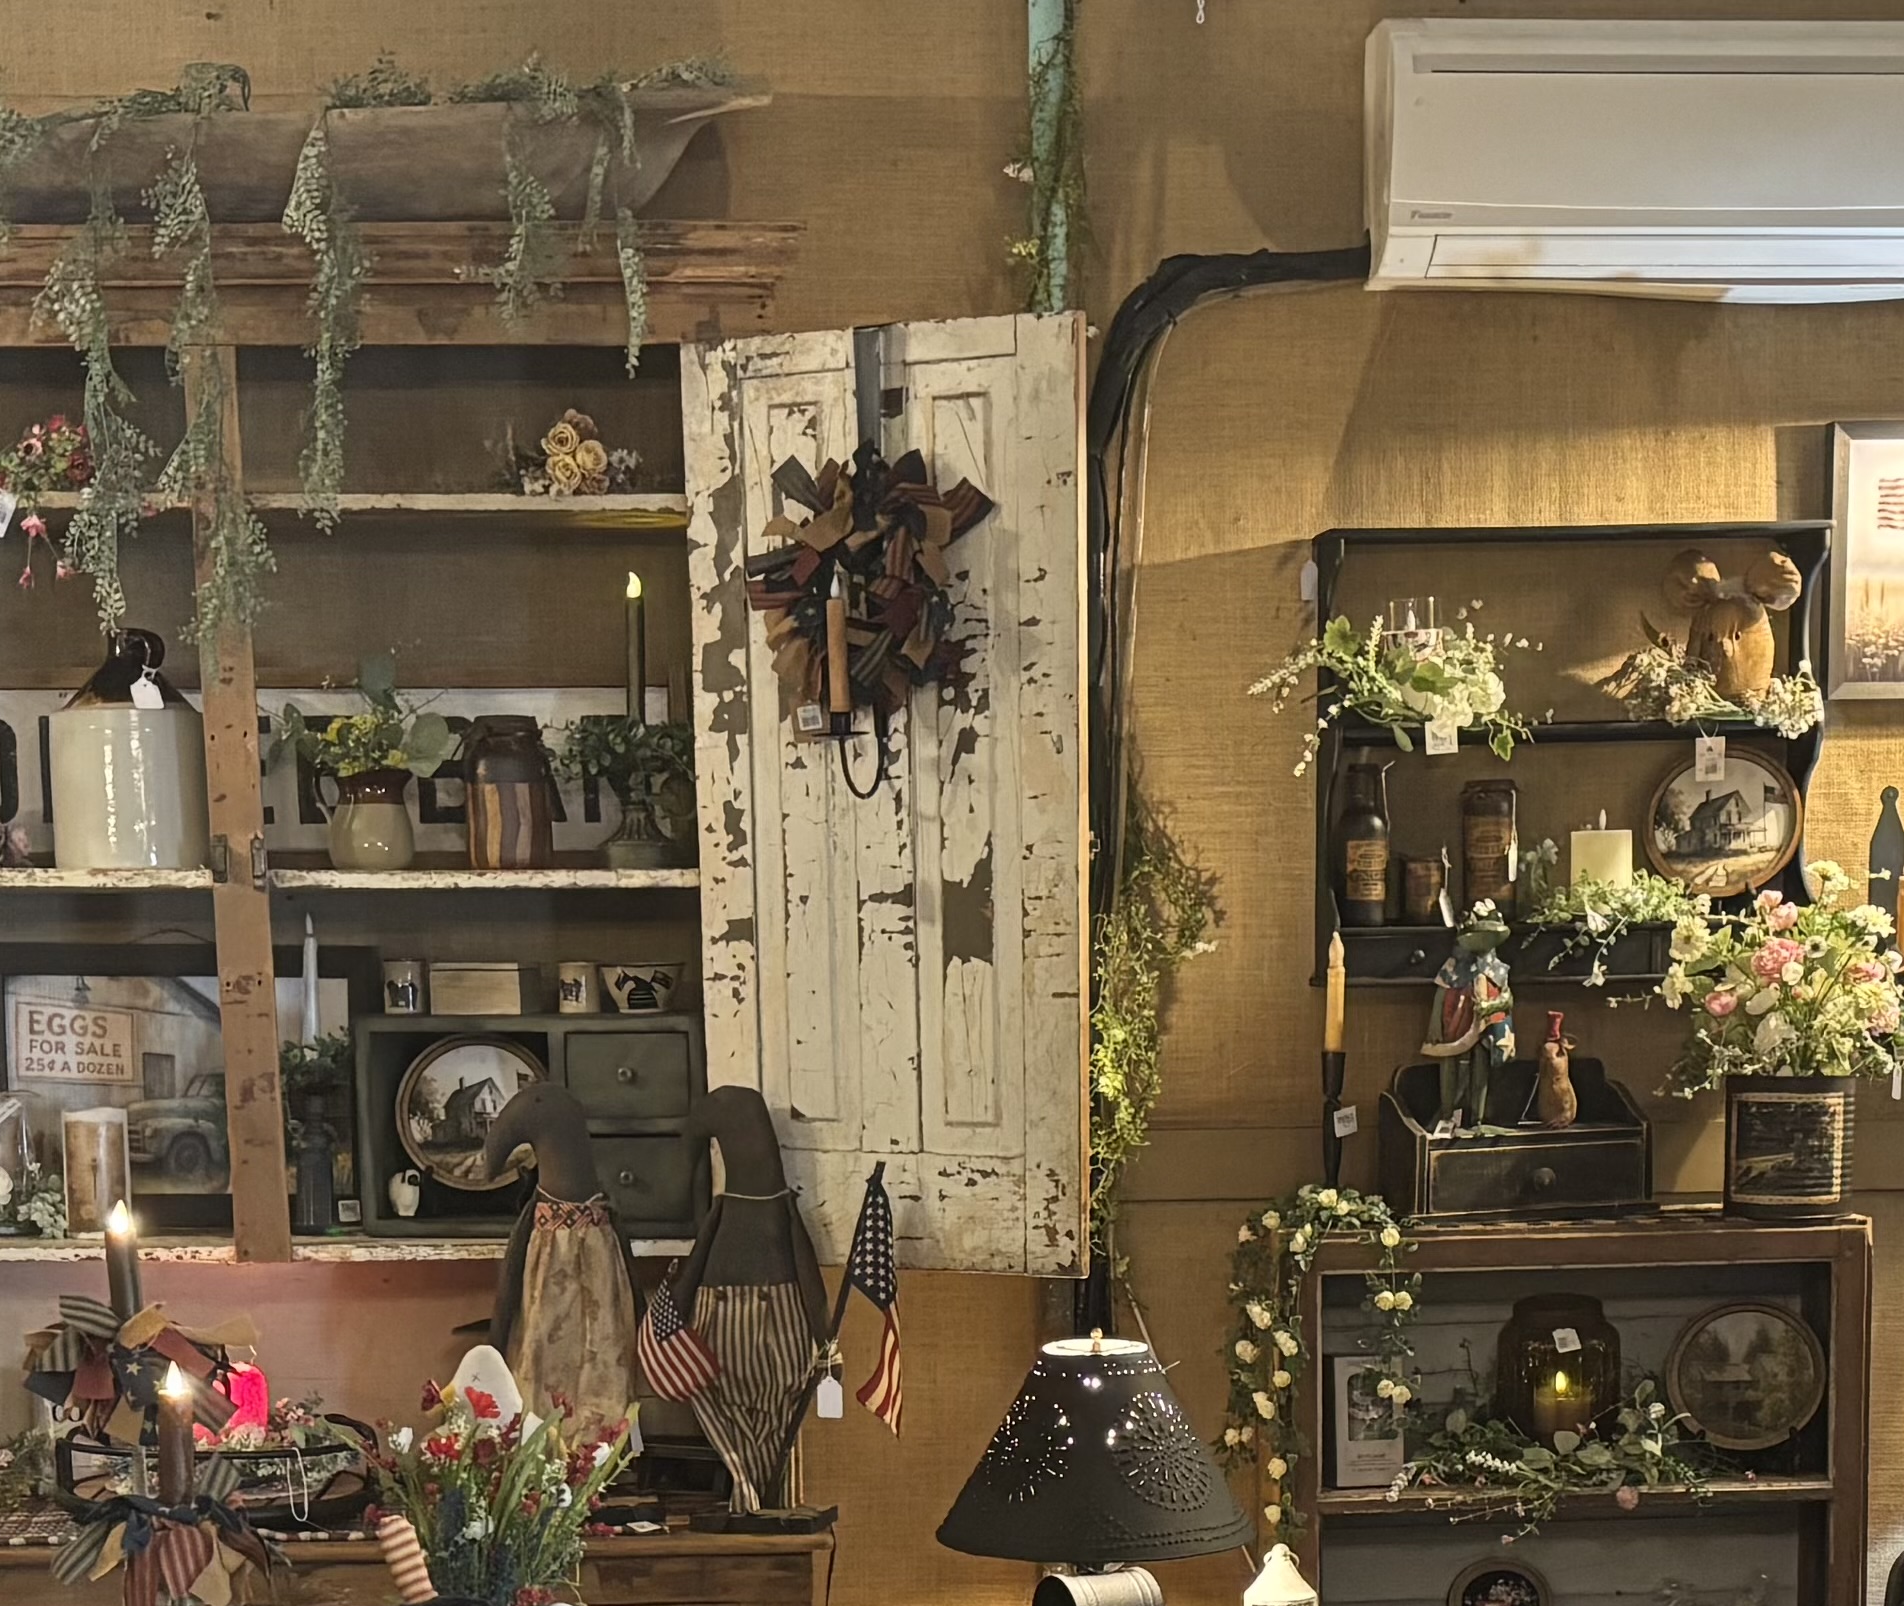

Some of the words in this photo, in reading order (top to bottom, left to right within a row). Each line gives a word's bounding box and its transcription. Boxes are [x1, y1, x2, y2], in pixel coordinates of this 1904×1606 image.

[28, 1010, 108, 1039] EGGS
[29, 1039, 66, 1055] FOR
[74, 1041, 122, 1058] SALE
[24, 1057, 56, 1073] 25¢
[60, 1061, 71, 1073] A
[76, 1061, 124, 1076] DOZEN
